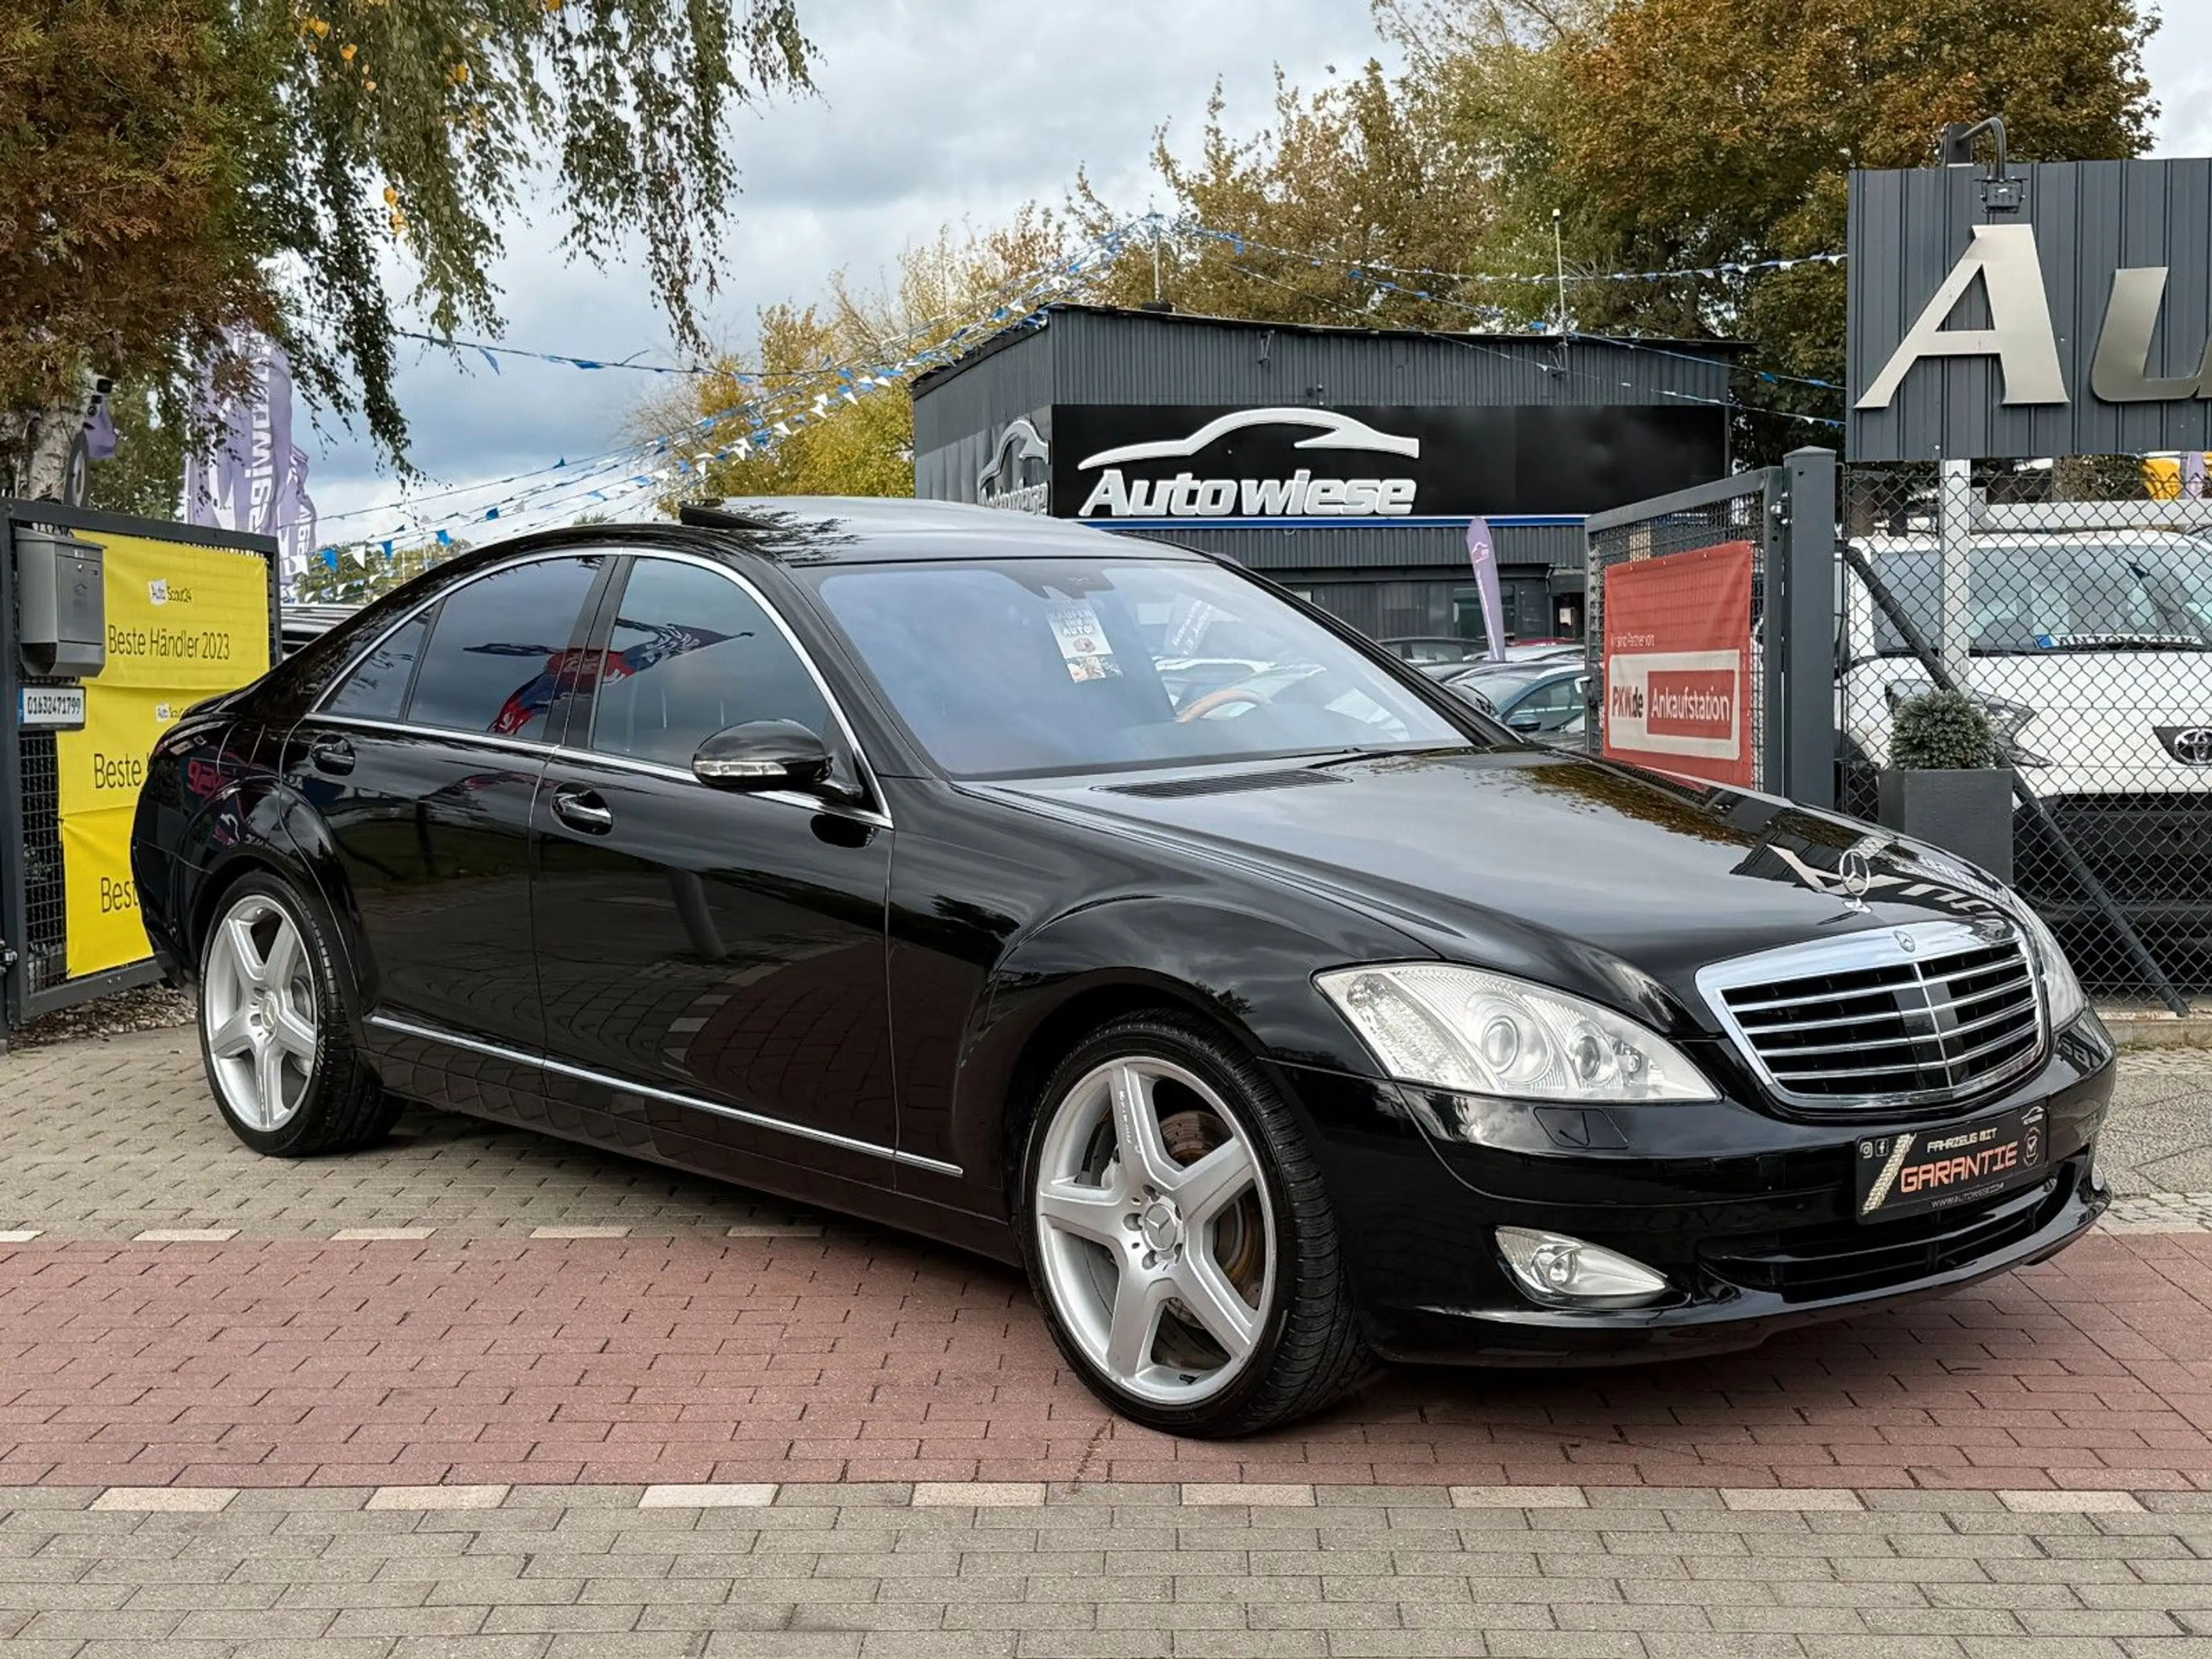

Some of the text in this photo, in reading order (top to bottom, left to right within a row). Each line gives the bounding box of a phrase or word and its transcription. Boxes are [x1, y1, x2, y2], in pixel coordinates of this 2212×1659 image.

[1078, 469, 1417, 516] Autowiese
[108, 624, 230, 660] Beste Händler 2023
[1652, 685, 1729, 721] Ankaufstation
[94, 753, 142, 789] Beste
[101, 877, 138, 912] Best
[1927, 1135, 1978, 1153] FAHRZEUG
[1901, 1141, 2018, 1194] GARANTIE
